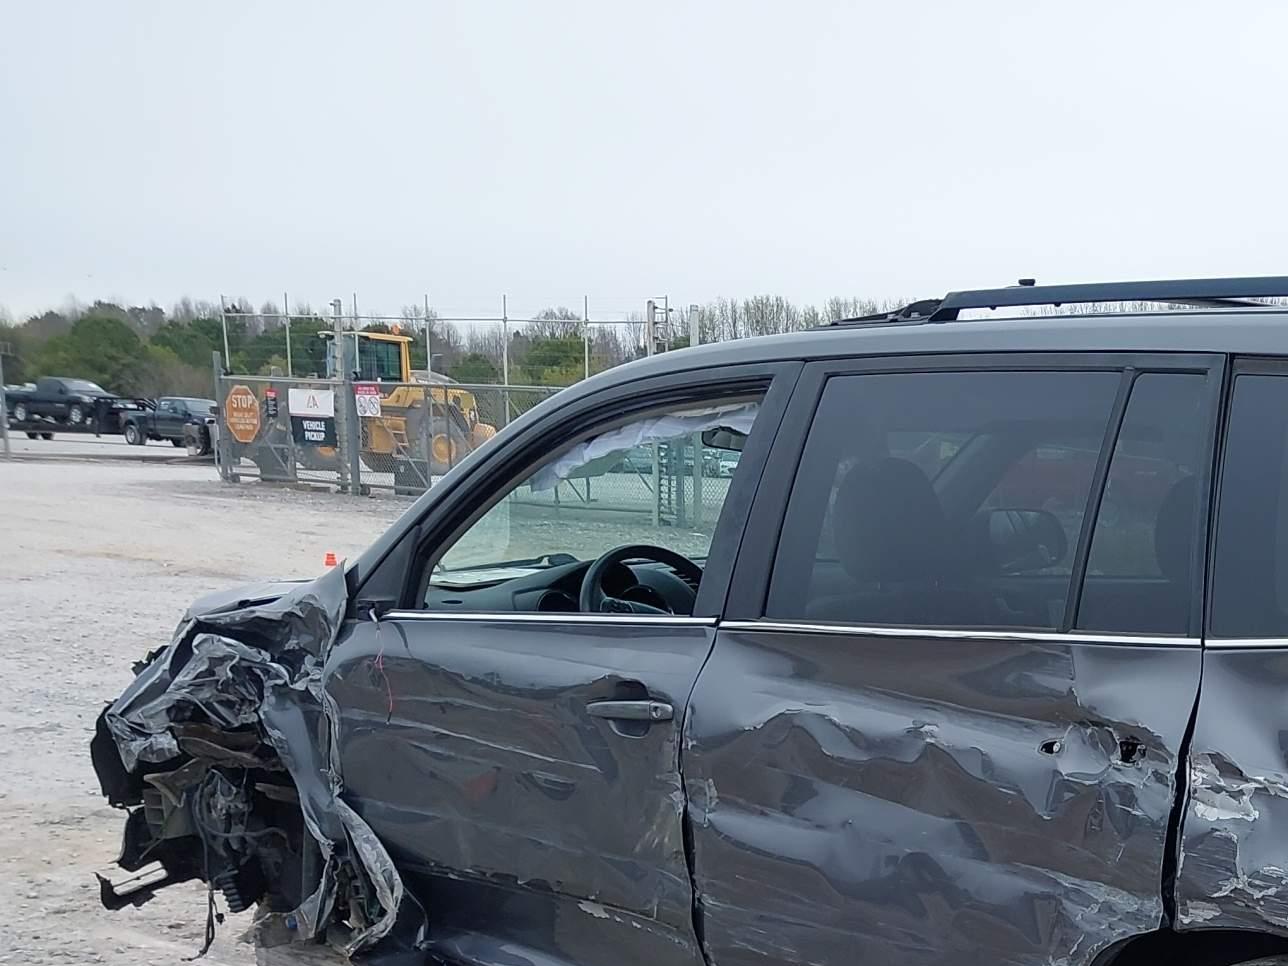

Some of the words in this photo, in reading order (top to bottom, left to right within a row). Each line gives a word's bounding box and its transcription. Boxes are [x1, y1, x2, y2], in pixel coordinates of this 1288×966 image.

[231, 394, 252, 408] STOP
[302, 420, 326, 431] VEHICLE
[304, 431, 326, 441] PICKUP
